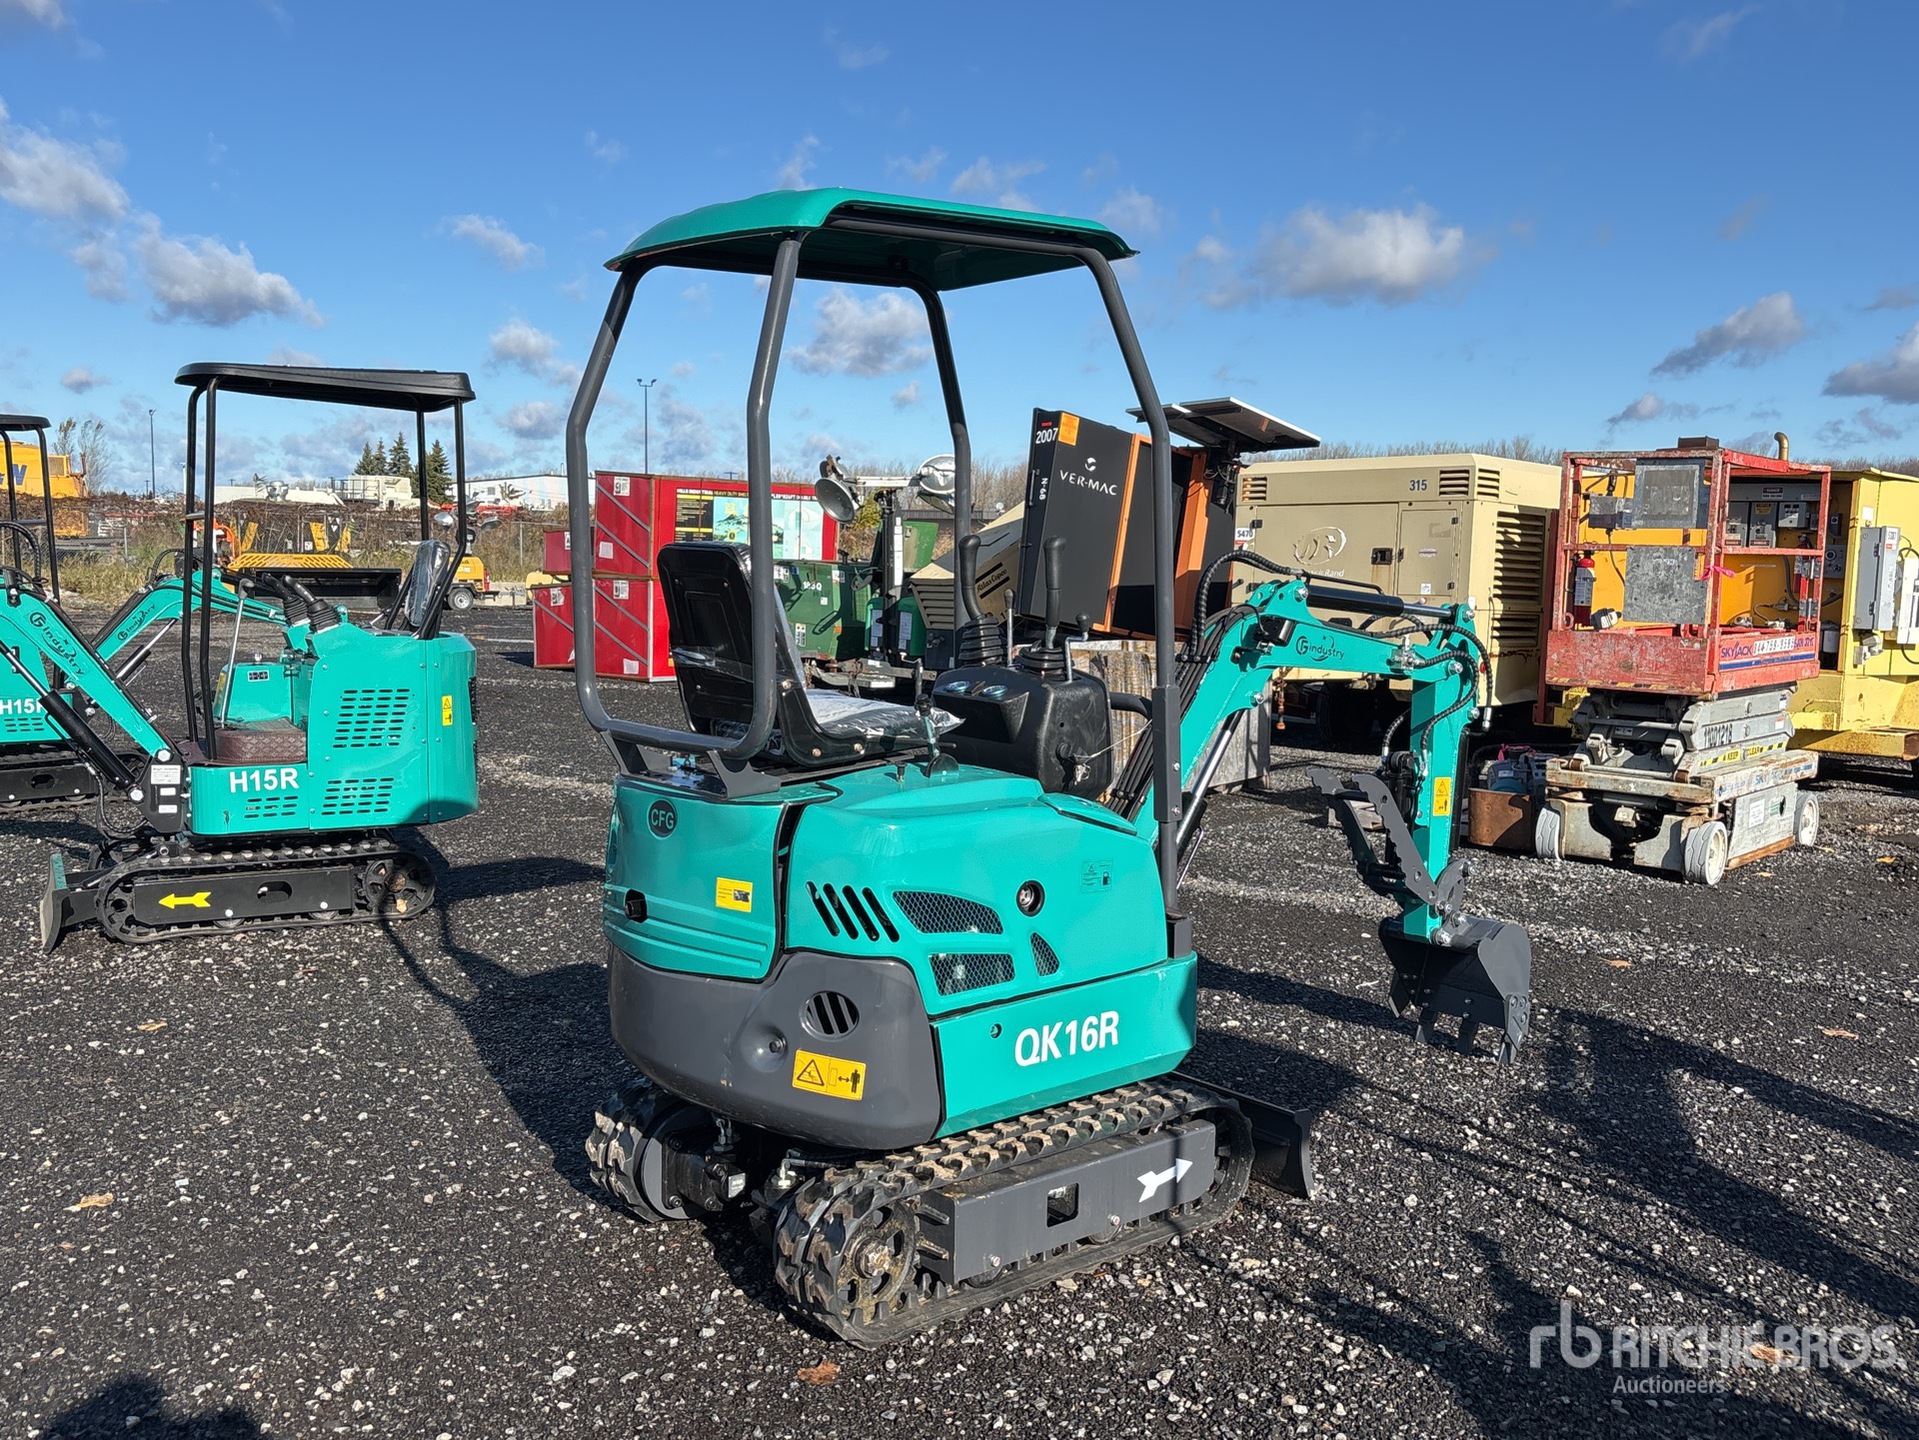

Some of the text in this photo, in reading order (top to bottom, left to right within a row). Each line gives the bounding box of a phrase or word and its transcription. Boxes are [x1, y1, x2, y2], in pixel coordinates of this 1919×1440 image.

[1035, 427, 1058, 444] 2007
[1409, 479, 1428, 492] 315
[229, 768, 300, 793] H15R
[651, 808, 675, 830] CFG
[1014, 1010, 1120, 1067] QK16R
